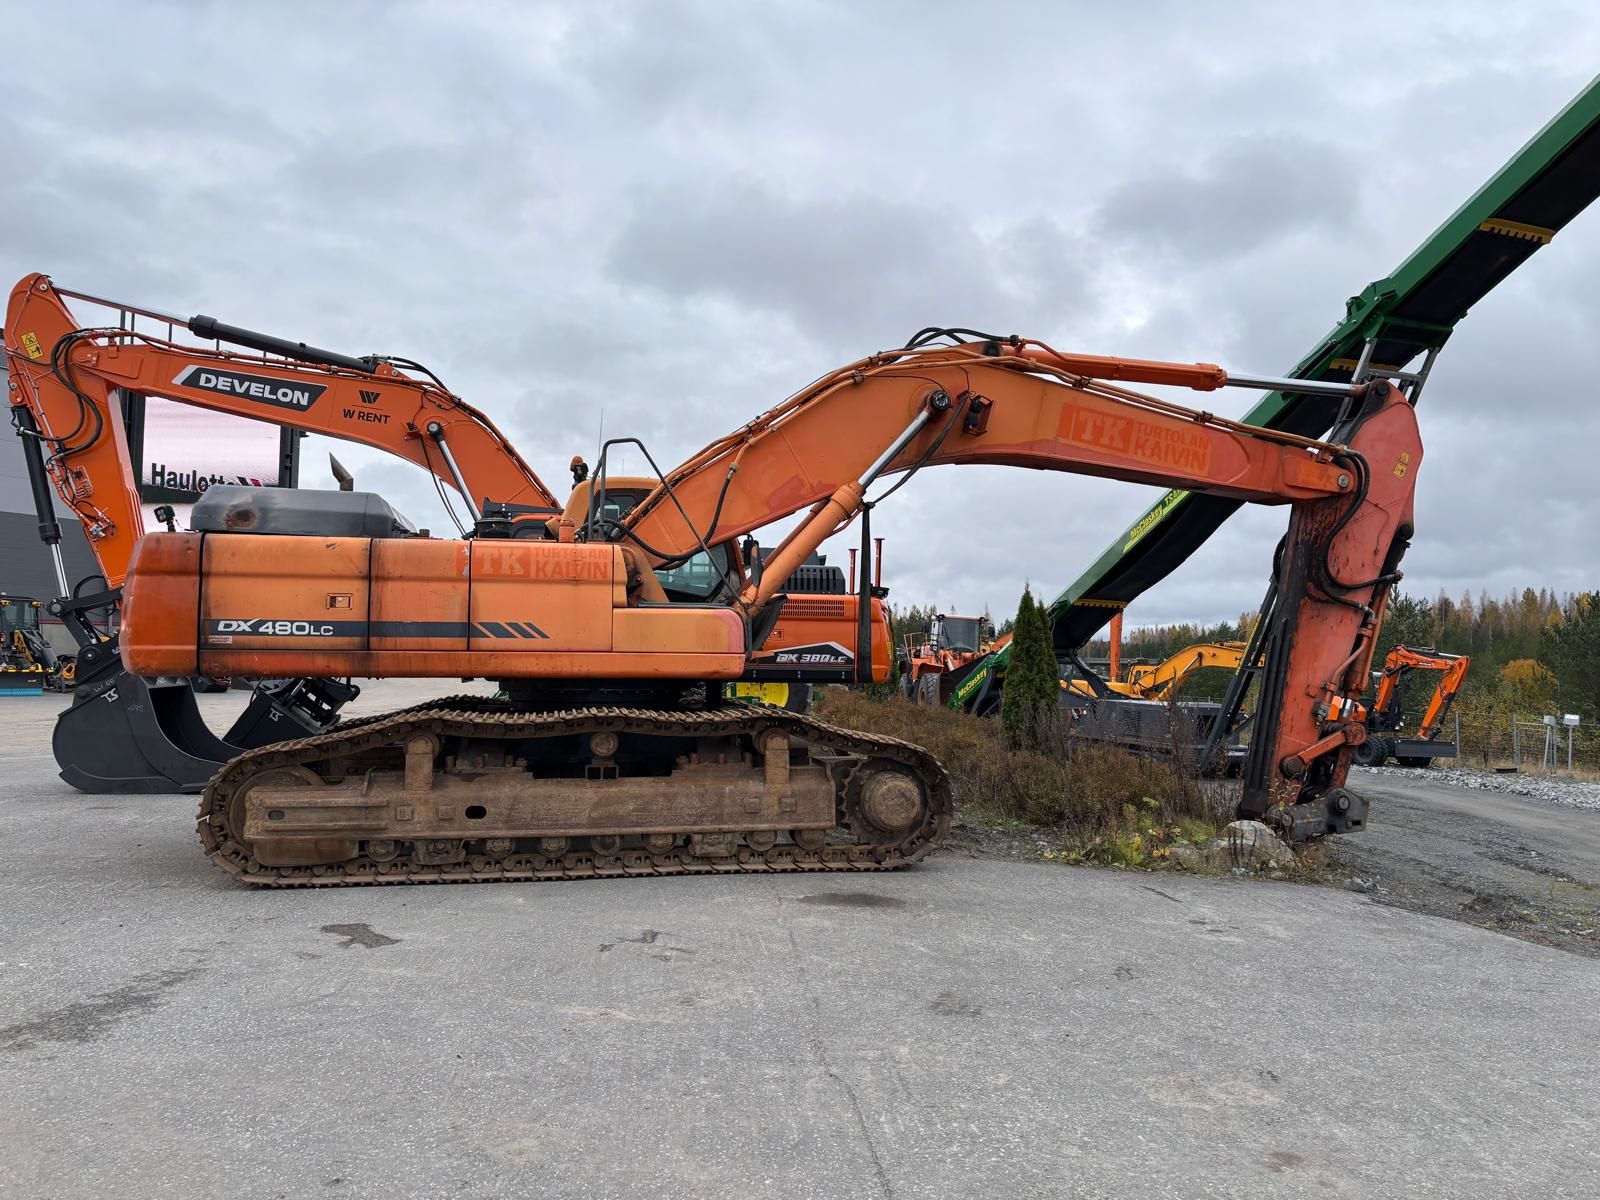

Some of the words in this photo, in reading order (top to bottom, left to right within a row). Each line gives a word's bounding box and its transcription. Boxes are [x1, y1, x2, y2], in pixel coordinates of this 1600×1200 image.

[200, 373, 309, 406] DEVELON
[343, 408, 355, 419] W
[357, 410, 391, 424] RENT
[1078, 410, 1127, 448] TK
[1136, 421, 1210, 450] TURTOLAN
[1130, 504, 1164, 539] McCloskey
[475, 549, 525, 575] TK
[217, 618, 261, 632] DX
[958, 667, 987, 698] McCloskey
